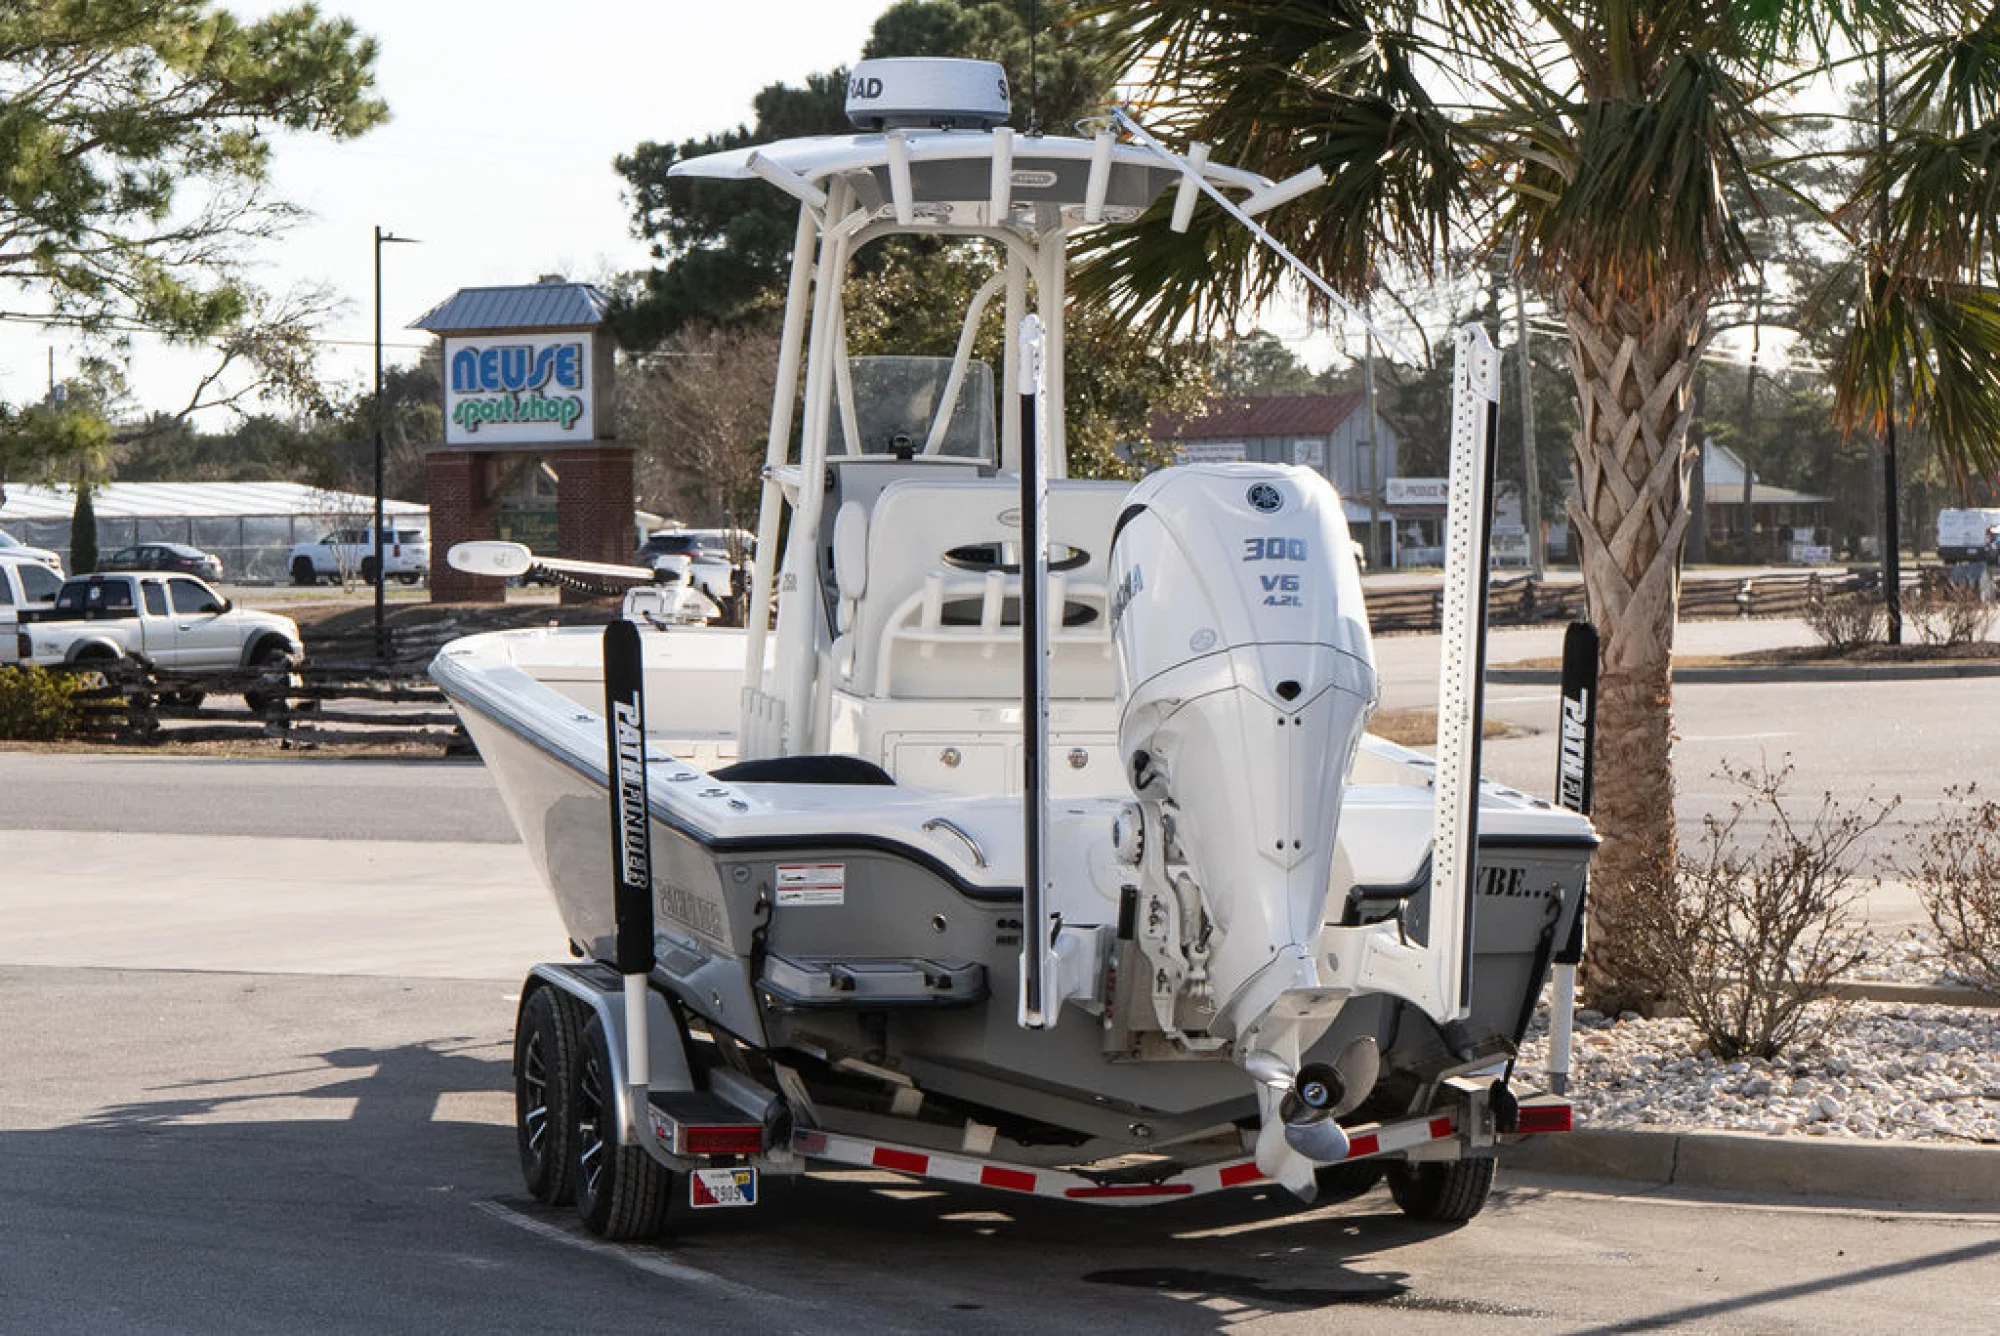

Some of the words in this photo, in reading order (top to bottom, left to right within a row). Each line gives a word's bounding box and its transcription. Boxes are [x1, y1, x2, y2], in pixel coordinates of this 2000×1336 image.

[453, 344, 581, 392] NEUSE
[453, 392, 514, 431] sport
[519, 392, 580, 430] shop
[1242, 537, 1308, 562] 300
[1259, 574, 1301, 592] V6
[1262, 595, 1304, 607] 4.2L
[613, 690, 649, 890] PATHFINDER
